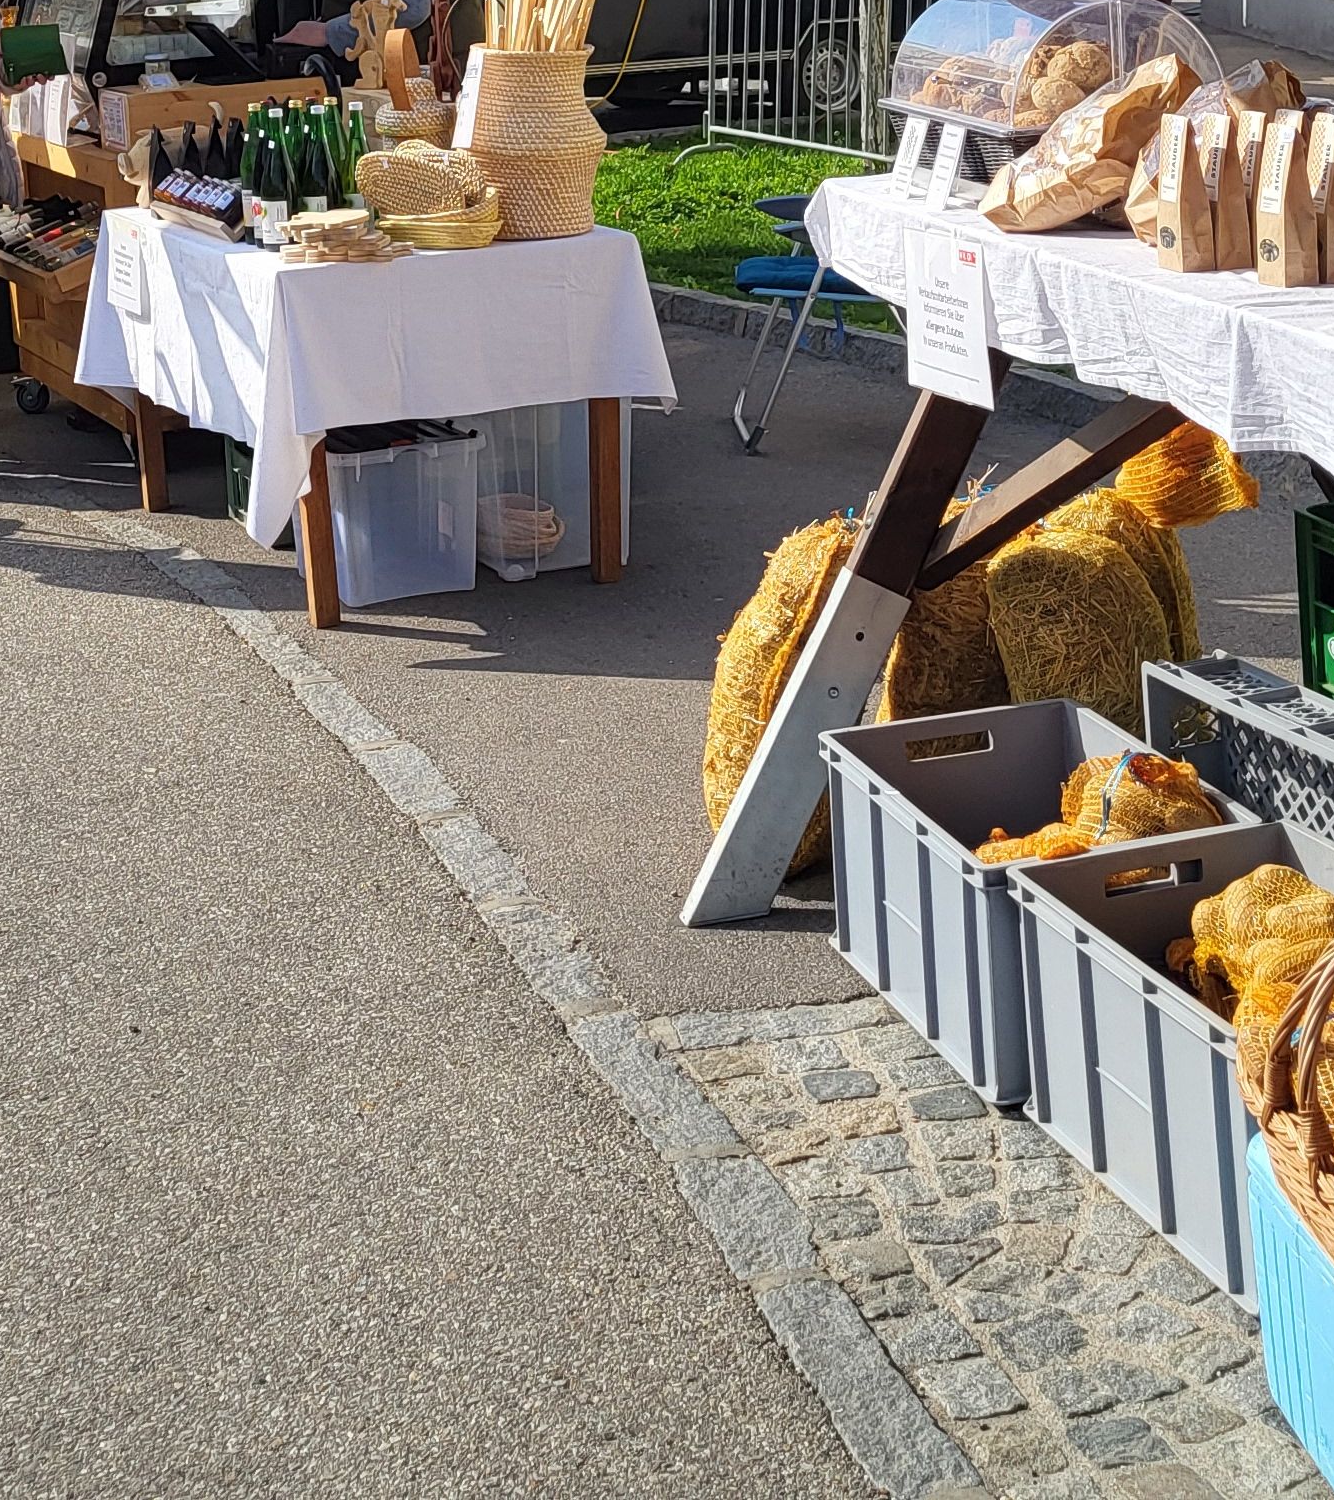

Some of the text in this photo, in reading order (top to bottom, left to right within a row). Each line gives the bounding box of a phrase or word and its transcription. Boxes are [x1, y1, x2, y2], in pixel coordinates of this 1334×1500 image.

[1170, 134, 1179, 180] STAUBER
[1274, 144, 1285, 192] STAUBER
[1320, 144, 1331, 191] STAUBER
